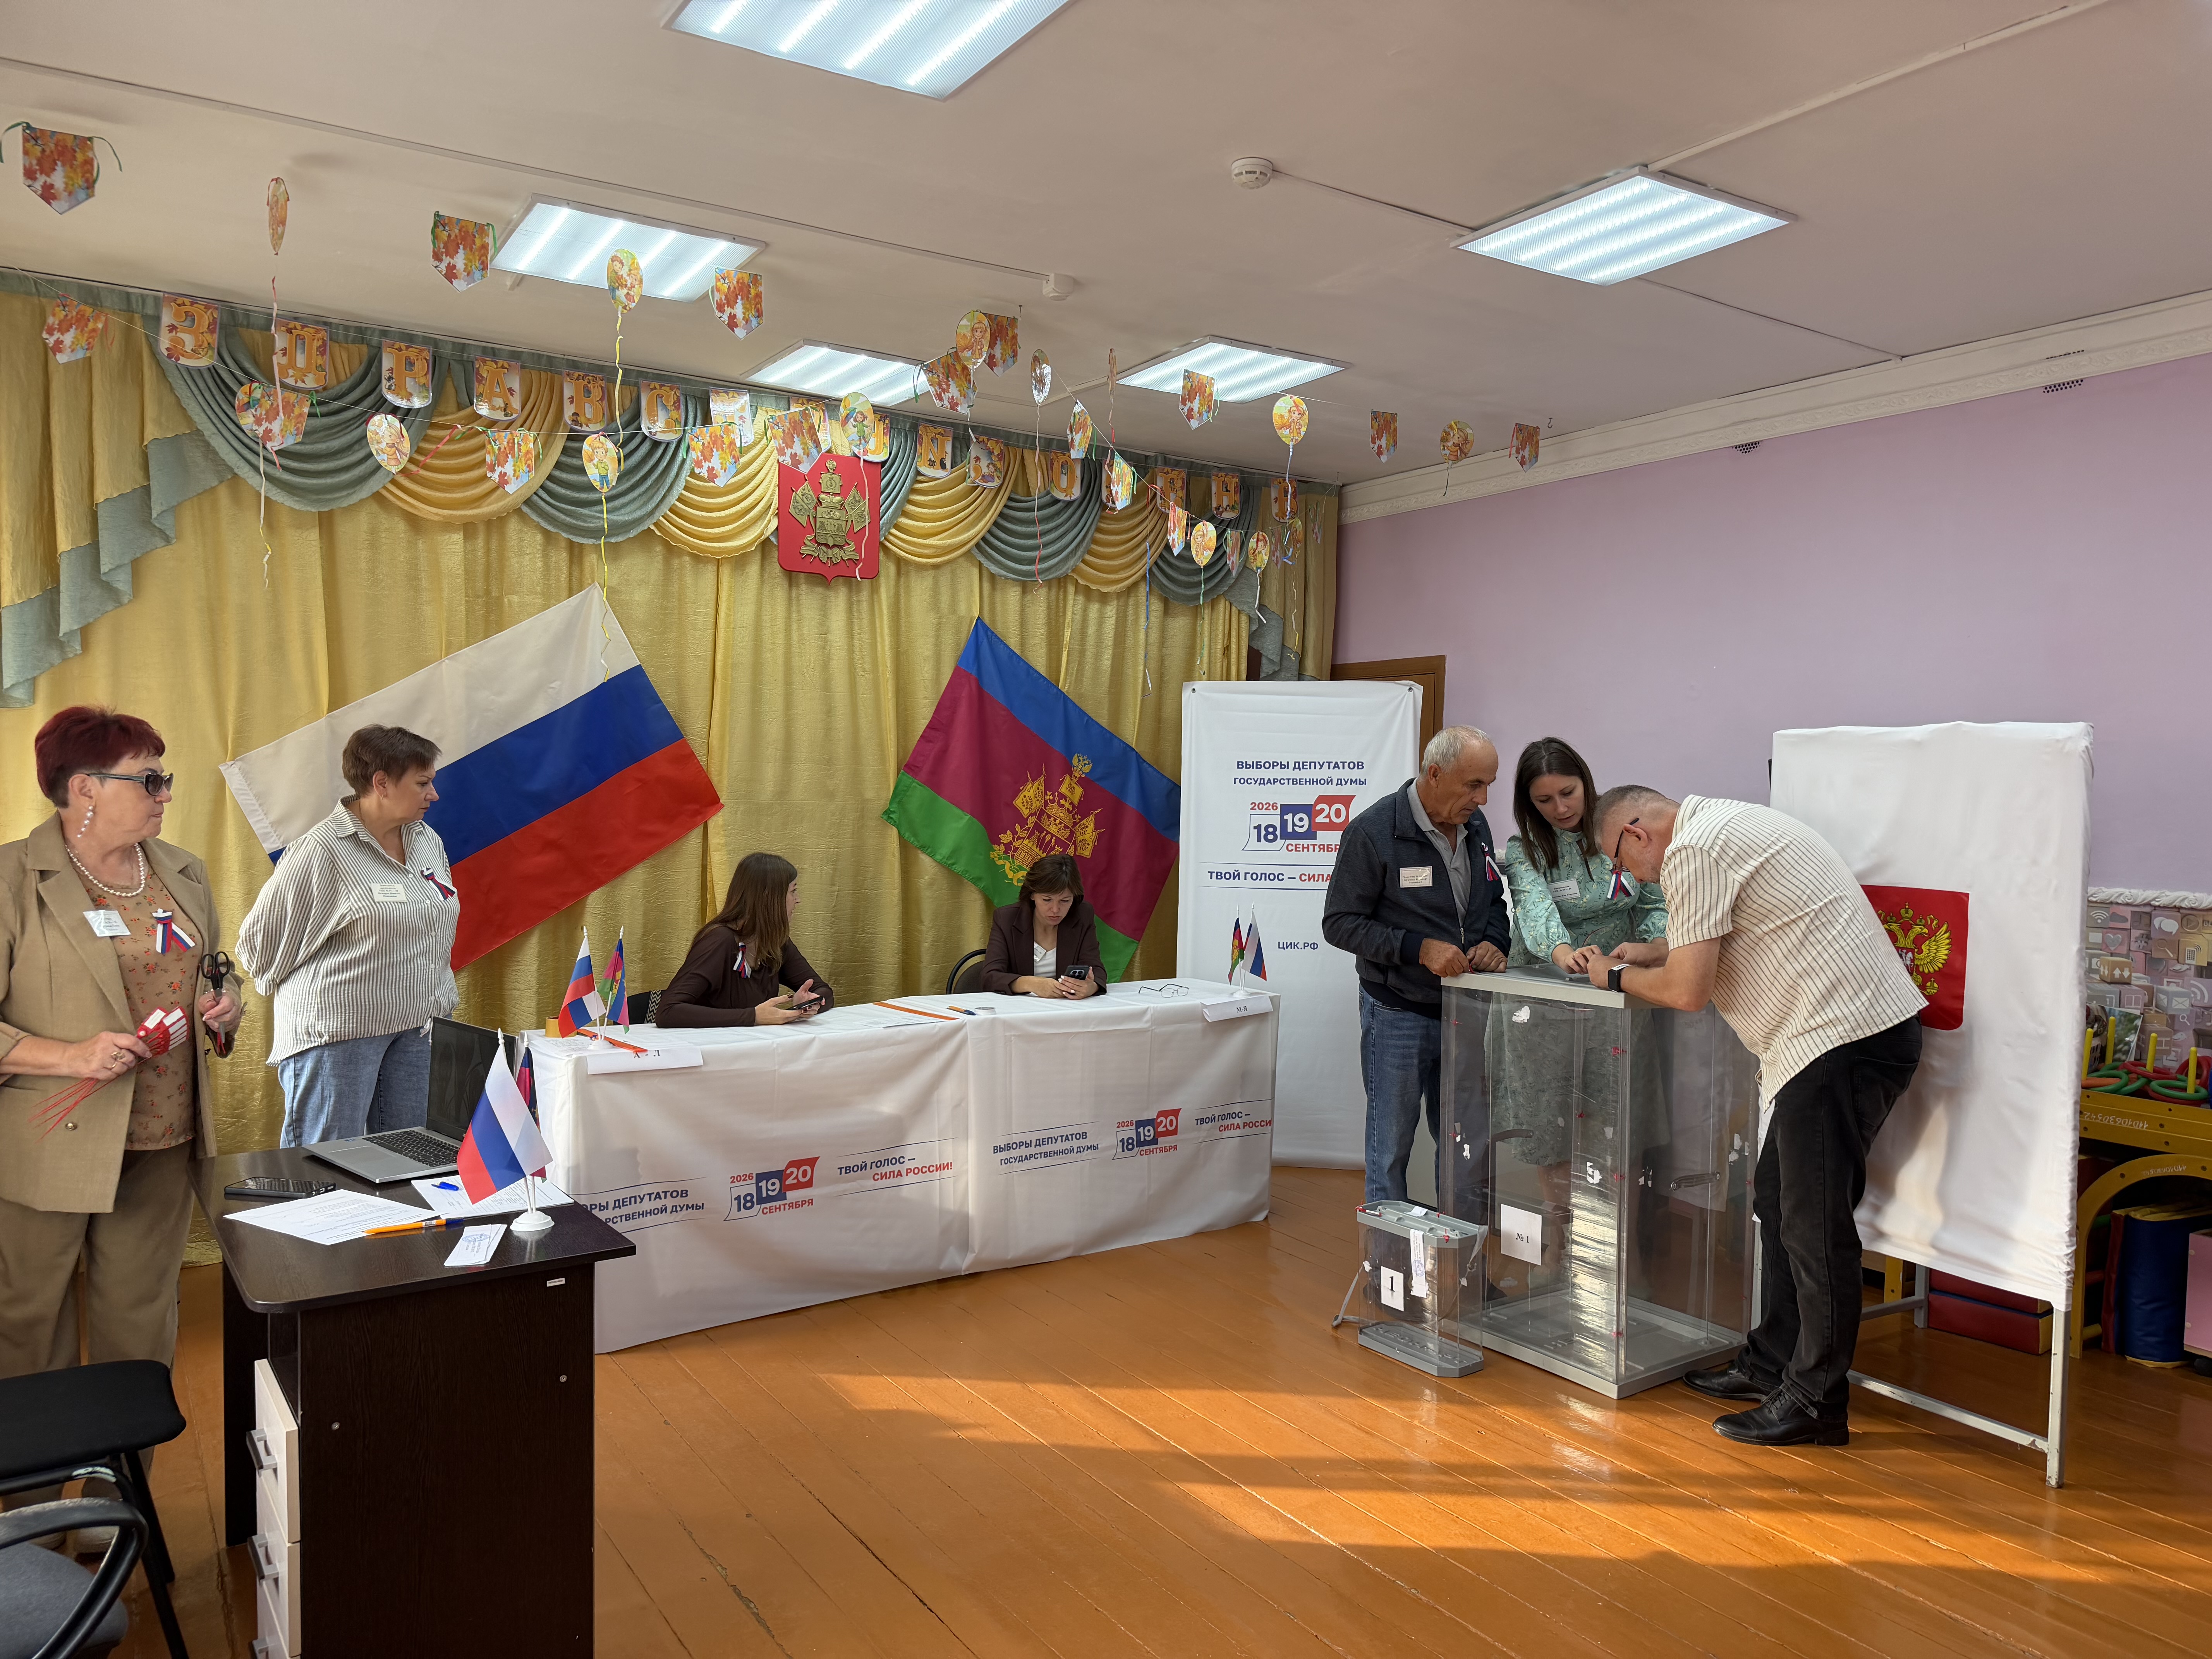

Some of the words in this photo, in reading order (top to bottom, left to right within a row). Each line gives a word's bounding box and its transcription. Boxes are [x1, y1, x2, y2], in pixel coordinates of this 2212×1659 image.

[1237, 761, 1289, 770] ВЫБОРЫ
[1292, 761, 1364, 771] ДЕПУТАТОВ
[1233, 776, 1333, 786] ГОСУДАРСТВЕННОЙ
[1336, 778, 1367, 786] ДУМЫ
[1250, 802, 1278, 811] 2026
[1253, 824, 1278, 843] 18
[1284, 813, 1309, 833] 19
[1315, 804, 1346, 823] 20
[1208, 869, 1240, 880] ТВОЙ
[1244, 872, 1285, 881] ГОЛОС
[1278, 941, 1319, 950] ЦИК.РФ
[1116, 1120, 1134, 1128] 2026
[1195, 1114, 1216, 1125] ТВОЙ
[1217, 1111, 1243, 1122] ГОЛОС
[1120, 1137, 1135, 1152] 18
[1138, 1126, 1154, 1142] 19
[1157, 1116, 1176, 1132] 20
[1219, 1123, 1241, 1132] СИЛА
[993, 1140, 1032, 1154] ВЫБОРЫ
[1034, 1132, 1087, 1148] ДЕПУТАТОВ
[1000, 1146, 1074, 1166] ГОСУДАРСТВЕННОЙ
[1076, 1144, 1099, 1154] ДУМЫ
[1139, 1144, 1177, 1156] СЕНТЯБРЯ
[837, 1161, 867, 1175] ТВОЙ
[870, 1156, 905, 1170] ГОЛОС
[872, 1169, 903, 1182] СИЛА
[905, 1162, 953, 1176] РОССИИ!
[730, 1173, 754, 1184] 2026
[734, 1193, 755, 1212] 18
[759, 1178, 780, 1198] 19
[785, 1165, 811, 1185] 20
[612, 1189, 689, 1211] ДЕПУТАТОВ
[762, 1198, 814, 1215] СЕНТЯБРЯ
[670, 1203, 704, 1214] ДУМЫ
[1515, 1233, 1524, 1242] №
[1389, 1276, 1395, 1292] 1
